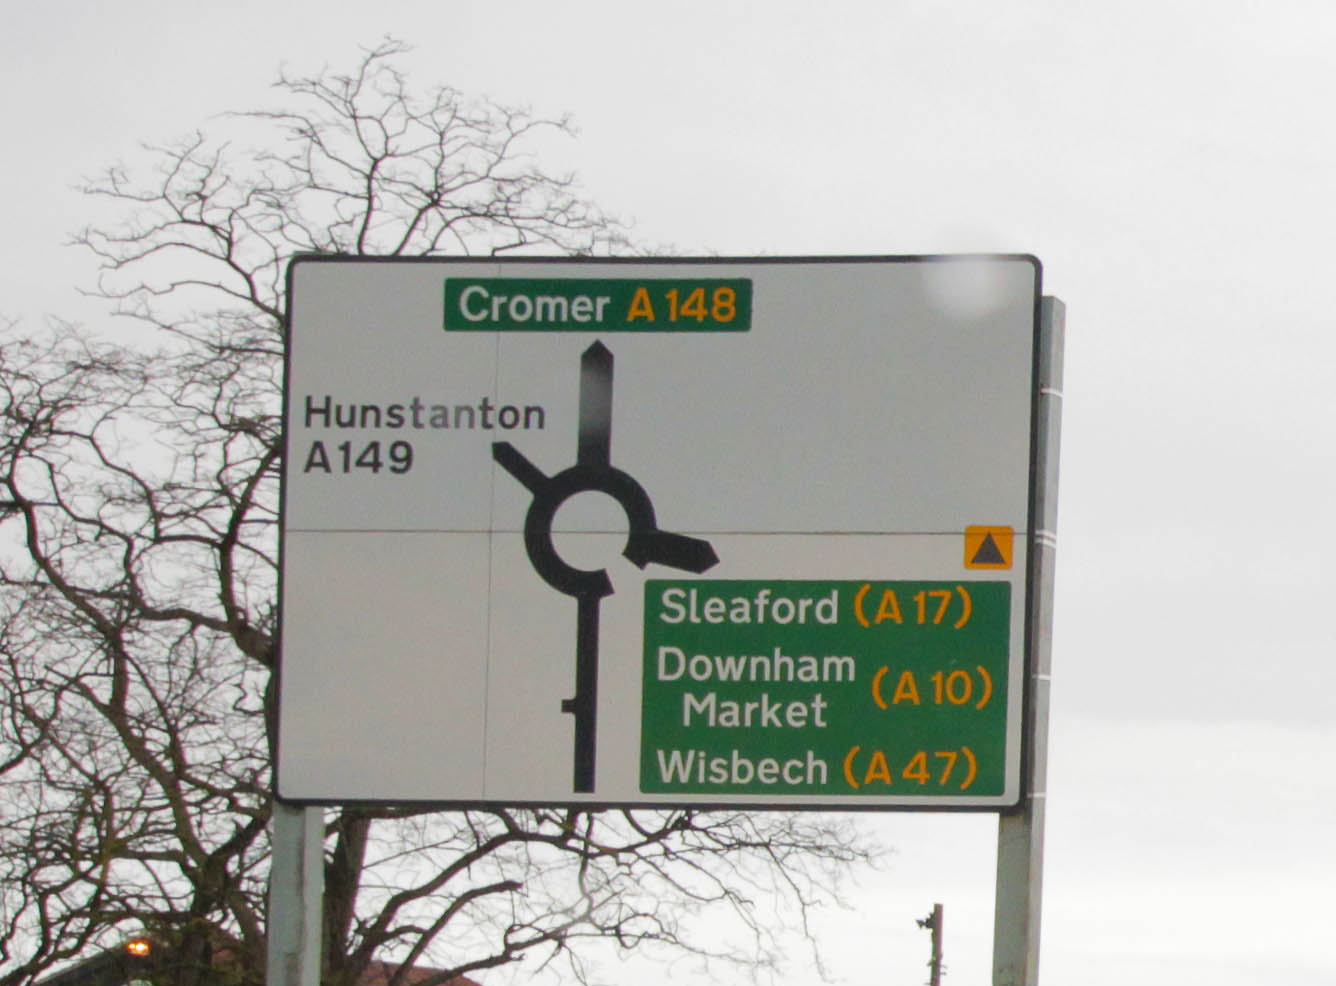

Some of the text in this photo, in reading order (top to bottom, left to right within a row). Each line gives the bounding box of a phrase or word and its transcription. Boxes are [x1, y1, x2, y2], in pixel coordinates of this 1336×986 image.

[459, 285, 611, 322] Cromer
[303, 395, 546, 430] Hunstanton
[659, 588, 839, 624] Sleaford
[657, 646, 855, 682] Downham
[682, 692, 828, 727] Market
[656, 750, 828, 785] Wisbech
